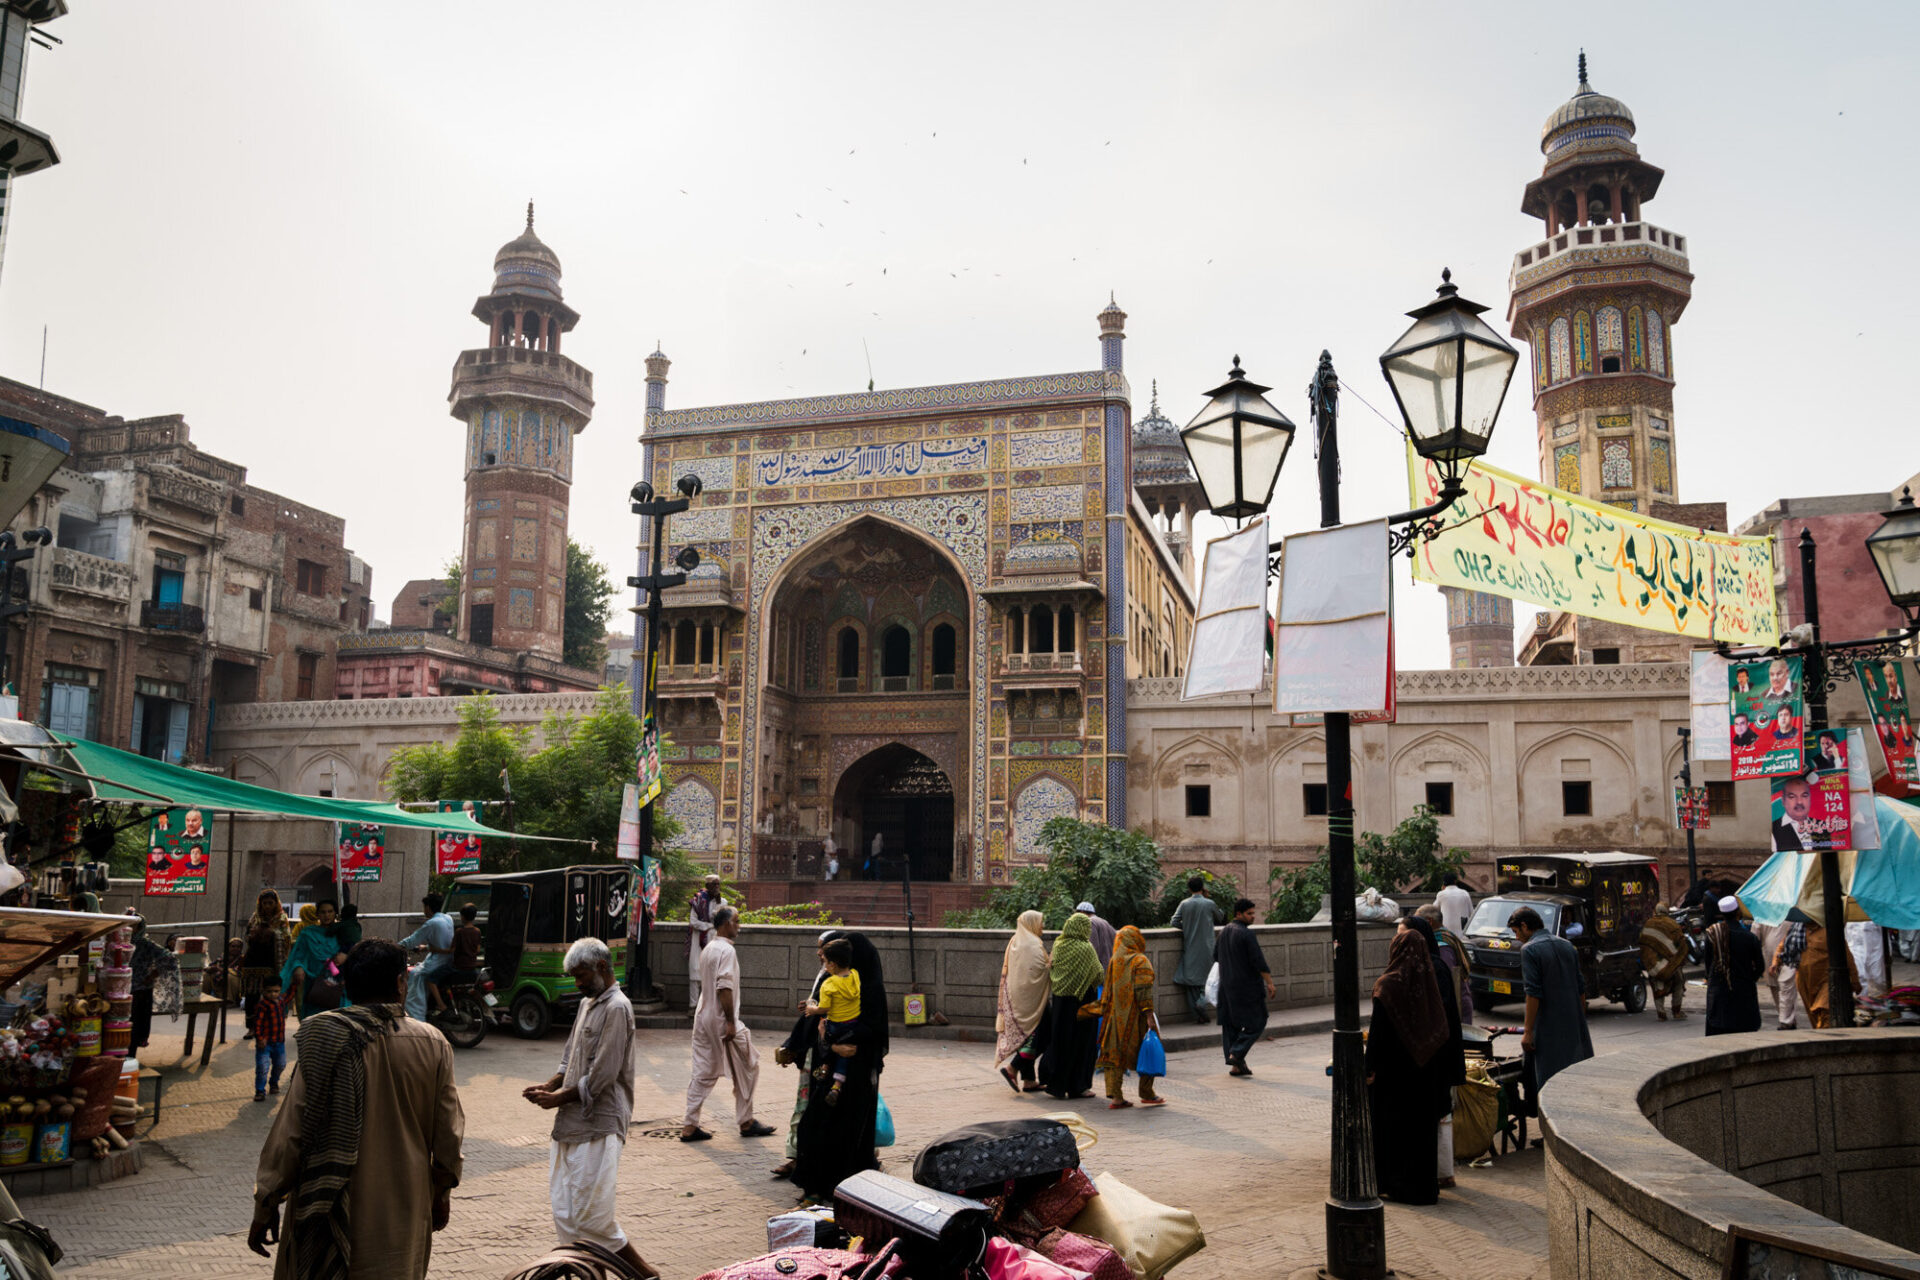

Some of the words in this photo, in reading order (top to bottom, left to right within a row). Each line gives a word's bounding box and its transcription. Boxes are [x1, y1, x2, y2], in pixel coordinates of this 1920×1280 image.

[1825, 792, 1842, 802] NA
[1824, 802, 1844, 812] 124
[1502, 864, 1520, 872] ZORO
[1621, 881, 1643, 895] ZORO
[1488, 939, 1511, 949] ZORO
